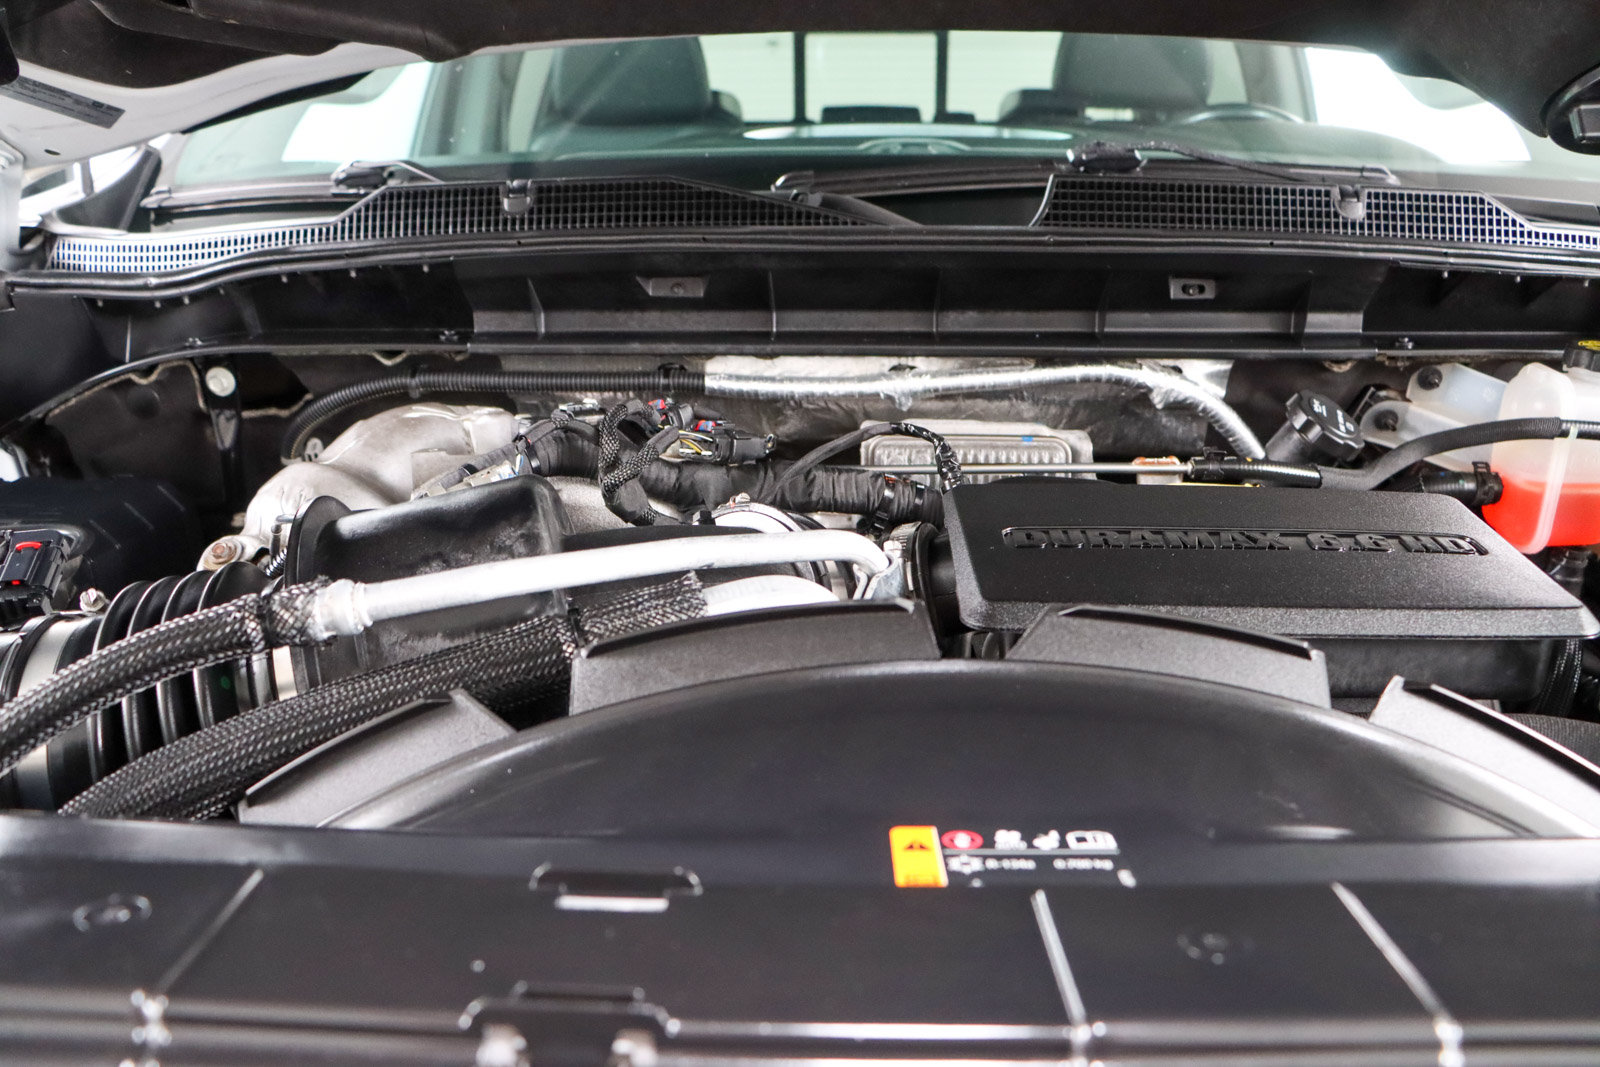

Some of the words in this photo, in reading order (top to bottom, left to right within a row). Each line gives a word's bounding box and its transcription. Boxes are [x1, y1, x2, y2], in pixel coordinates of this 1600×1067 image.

[1006, 529, 1291, 550] DURAMAX
[1306, 532, 1393, 552] 6.6
[1399, 535, 1477, 554] HD
